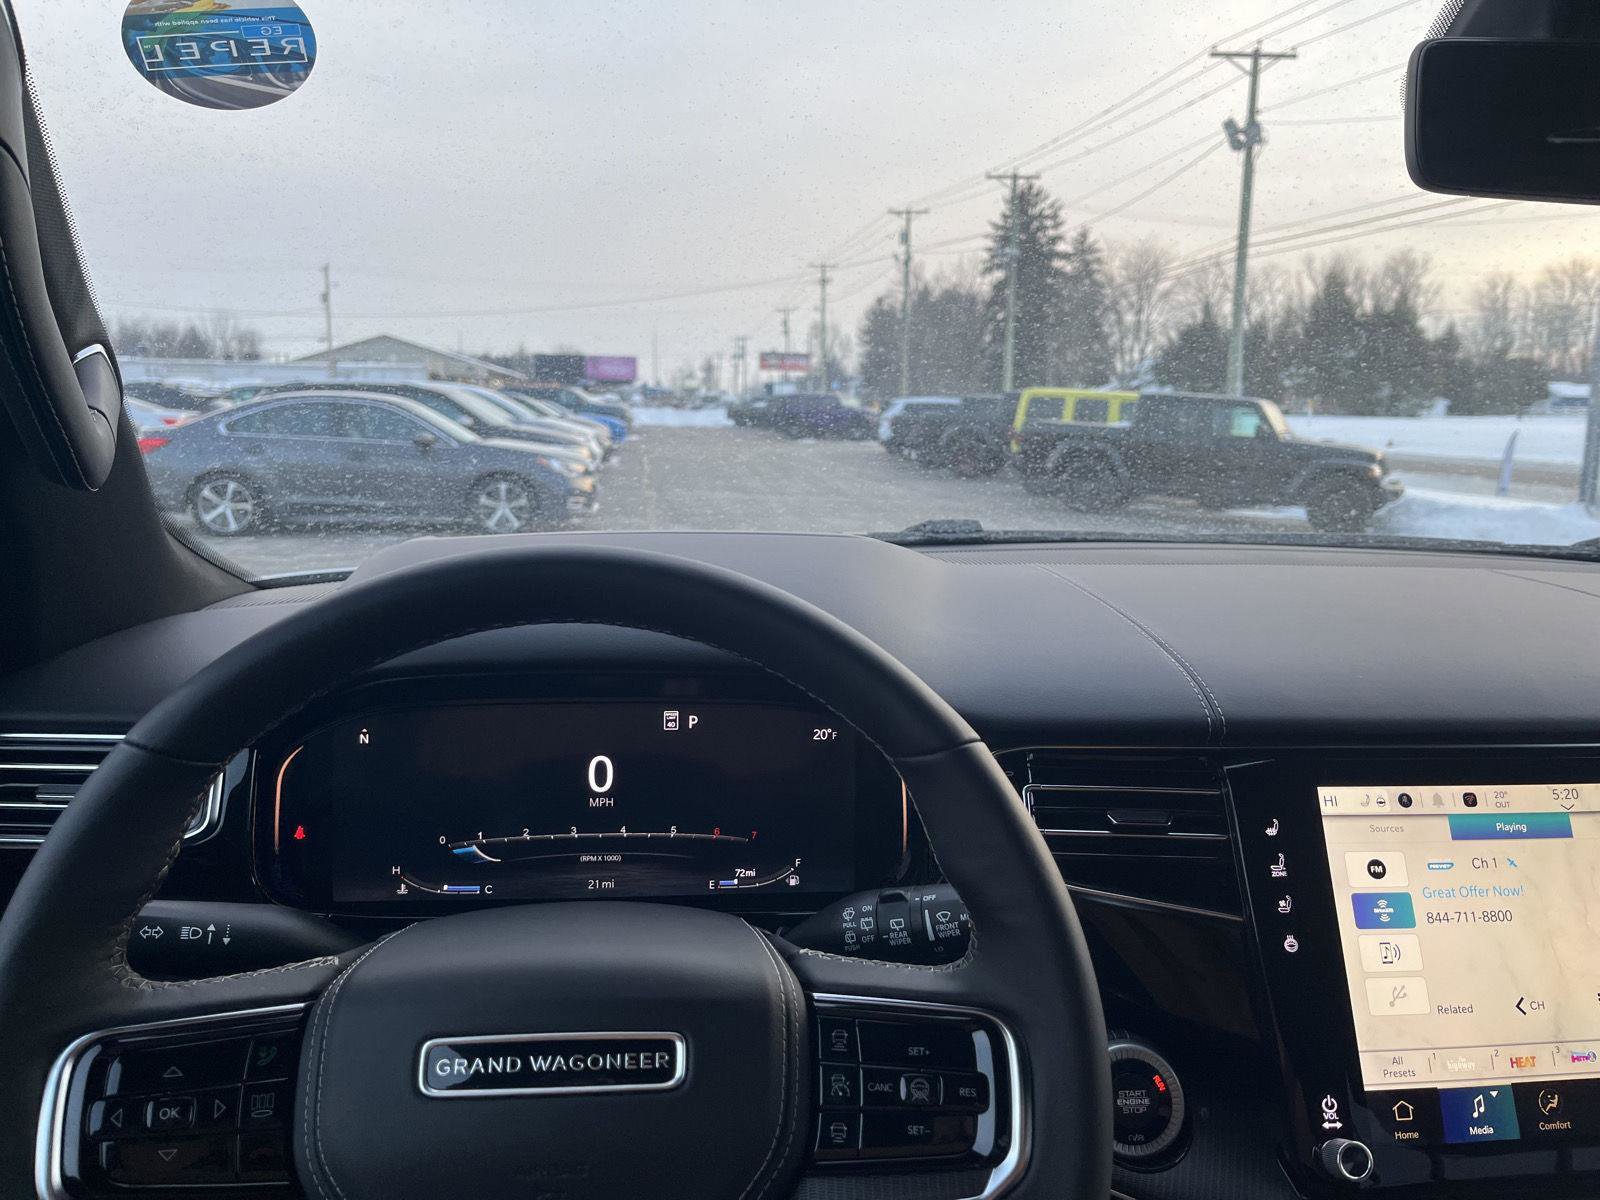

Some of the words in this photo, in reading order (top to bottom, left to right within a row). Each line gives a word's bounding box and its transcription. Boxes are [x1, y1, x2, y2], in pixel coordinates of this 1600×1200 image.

[688, 715, 699, 729] P
[359, 733, 369, 744] N
[588, 755, 614, 793] 0
[1494, 790, 1508, 799] 20°
[1552, 788, 1579, 801] 5:20
[589, 797, 614, 808] MPH
[1324, 795, 1338, 807] HI
[1495, 801, 1510, 809] OUT
[1369, 823, 1404, 833] Sources
[1496, 821, 1527, 833] Playing
[439, 835, 446, 844] 0
[477, 831, 483, 840] 1
[523, 828, 530, 838] 2
[570, 826, 577, 835] 3
[620, 825, 627, 834] 4
[671, 825, 677, 835] 5
[713, 827, 721, 836] 6
[751, 831, 758, 839] 7
[795, 858, 801, 868] F
[1472, 857, 1489, 869] Ch
[1492, 857, 1498, 868] 1
[392, 866, 400, 875] H
[1370, 865, 1383, 874] FM
[588, 879, 600, 889] 21
[601, 879, 615, 889] mi
[709, 881, 715, 889] E
[485, 885, 493, 894] C
[1422, 886, 1456, 899] Great
[1459, 885, 1489, 898] Offer
[1493, 885, 1525, 897] Now!
[1426, 910, 1513, 924] 844-711-8800
[936, 921, 959, 931] FRONT
[861, 934, 875, 943] OFF
[889, 930, 908, 939] REAR
[937, 929, 961, 939] WIPER
[889, 937, 912, 946] WIPER
[1437, 1004, 1474, 1015] Related
[1530, 1001, 1545, 1011] CH
[908, 1047, 931, 1056] SET+
[1494, 1049, 1499, 1057] 2
[1555, 1045, 1560, 1054] 3
[1392, 1056, 1404, 1066] All
[1432, 1052, 1436, 1060] 1
[436, 1056, 522, 1077] GRAND
[529, 1051, 670, 1072] WAGONEER
[1509, 1056, 1537, 1069] HEAT
[1383, 1068, 1416, 1079] Presets
[867, 1083, 894, 1093] CANC
[959, 1088, 977, 1097] RES
[1118, 1090, 1147, 1098] START
[1117, 1098, 1151, 1106] ENGINE
[159, 1107, 181, 1120] OK
[1122, 1106, 1147, 1114] STOP
[1469, 1126, 1494, 1136] Media
[1539, 1121, 1571, 1131] Comfort
[1395, 1131, 1419, 1140] Home
